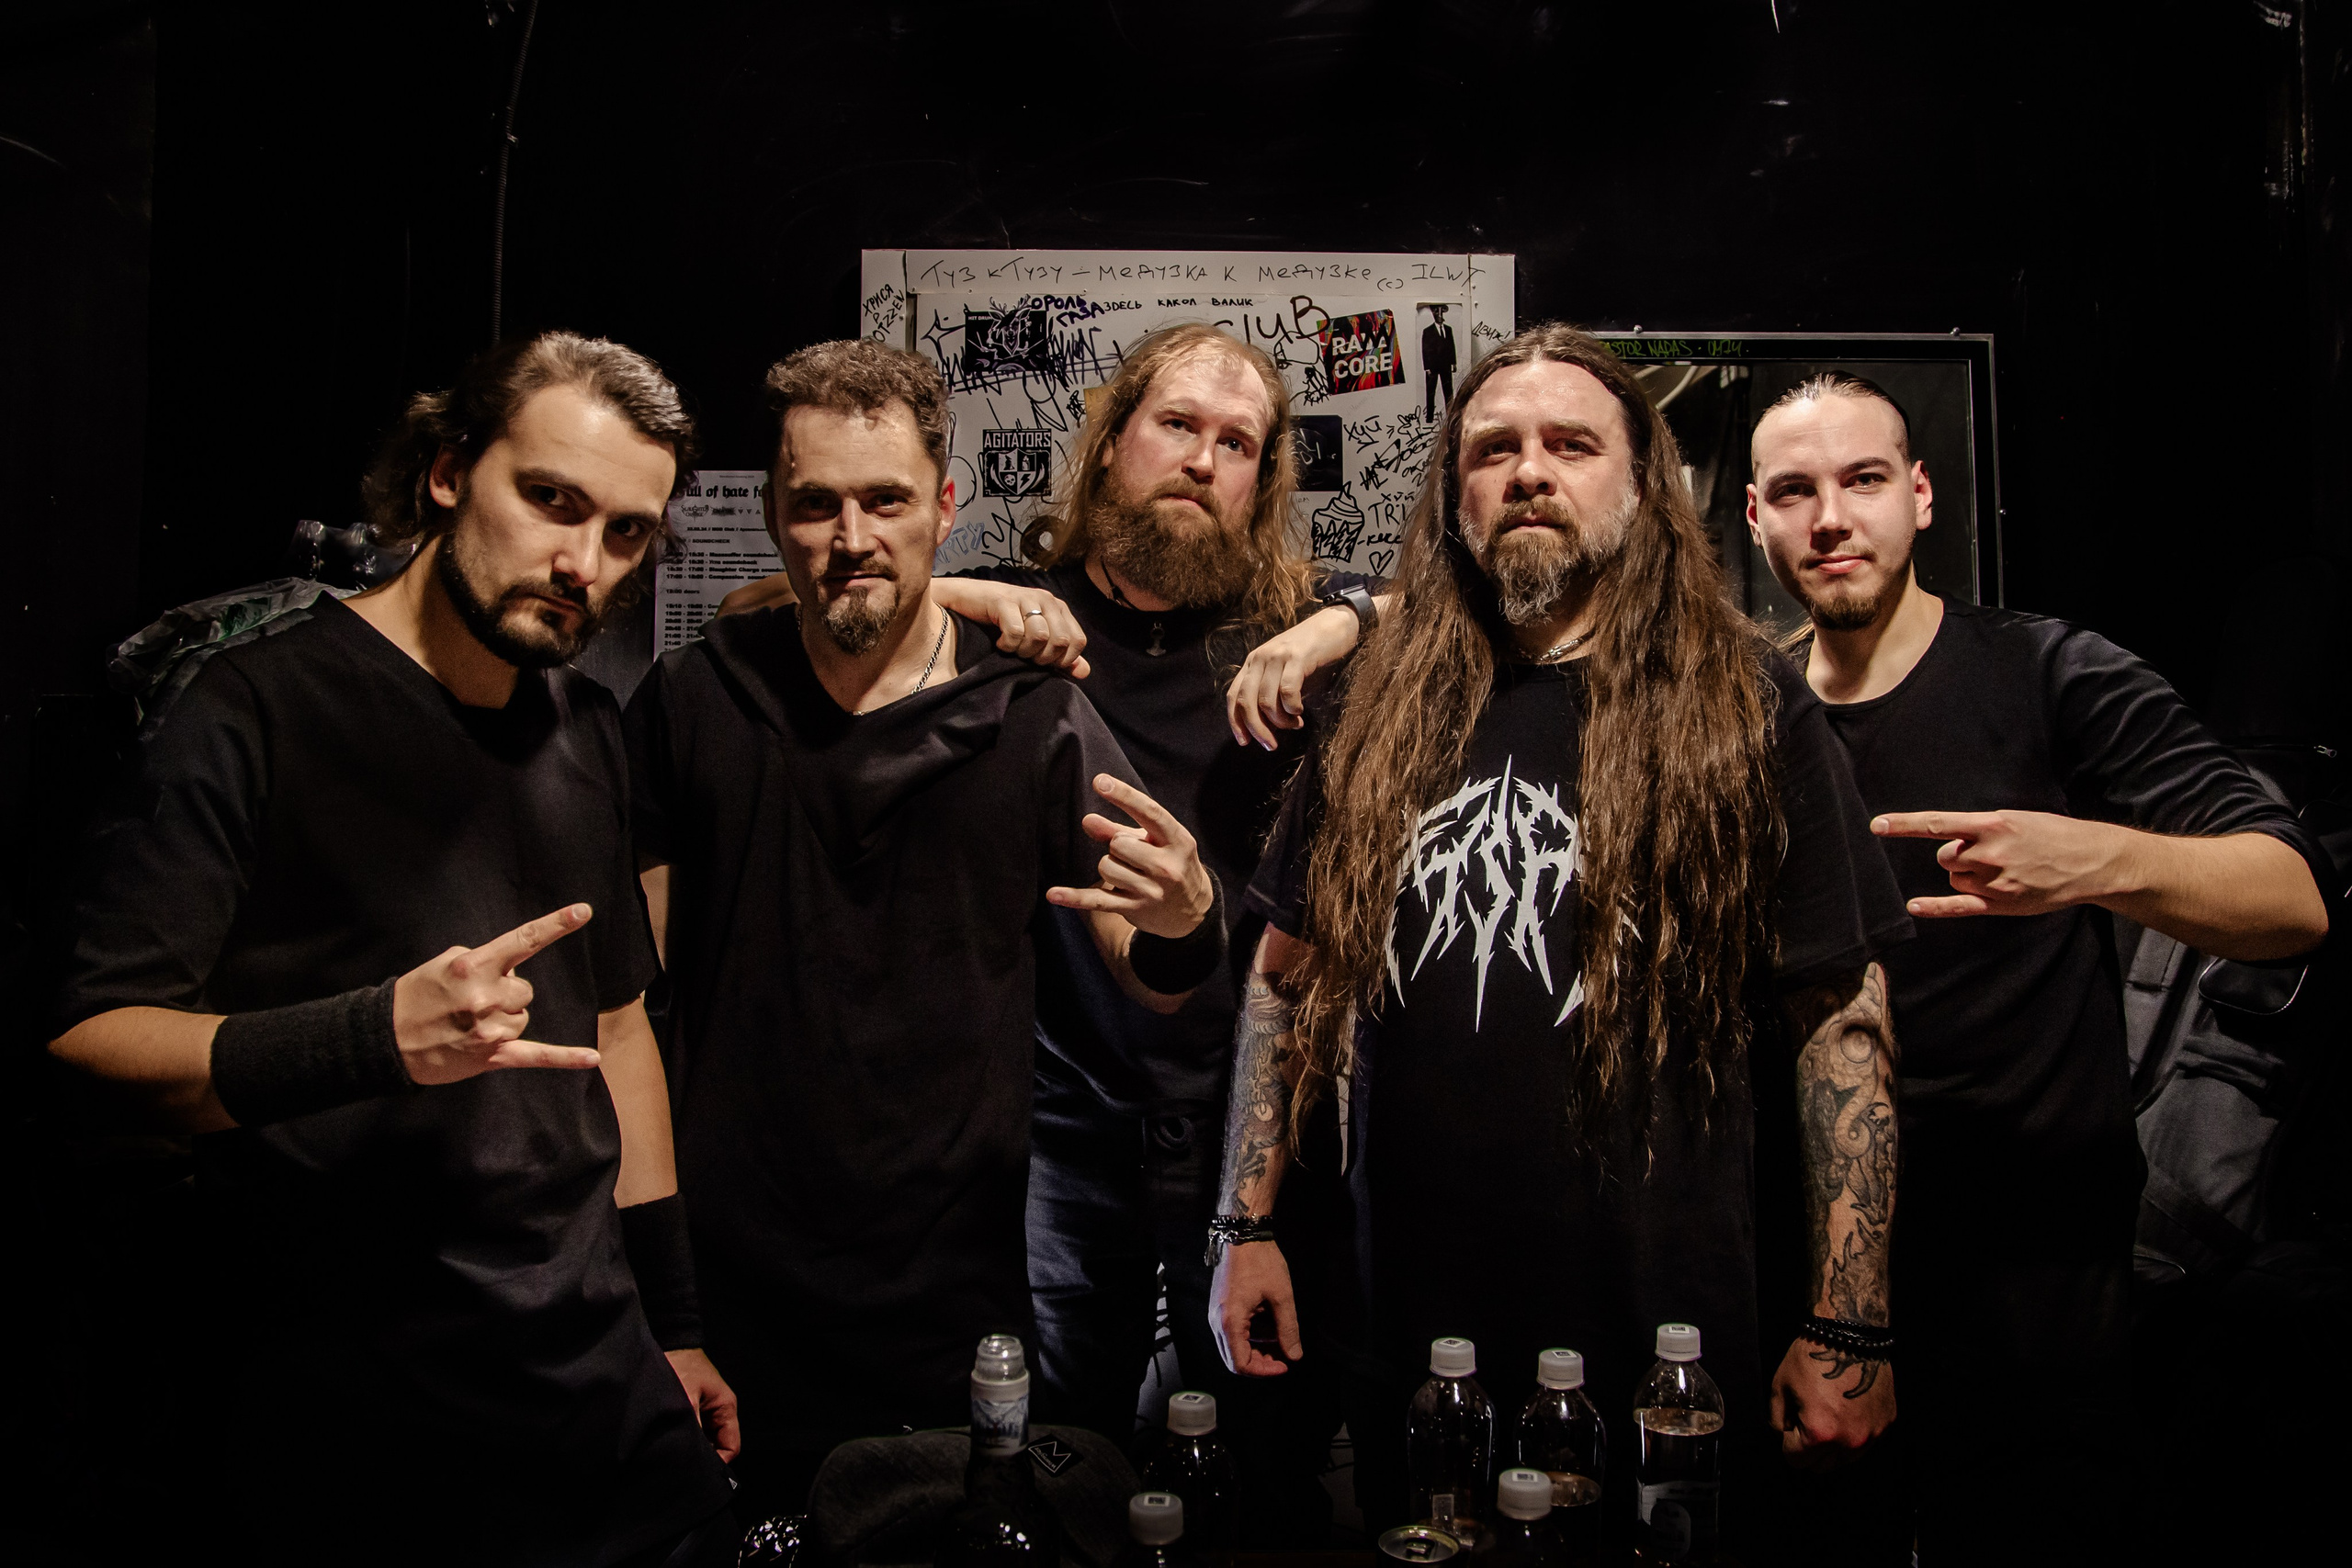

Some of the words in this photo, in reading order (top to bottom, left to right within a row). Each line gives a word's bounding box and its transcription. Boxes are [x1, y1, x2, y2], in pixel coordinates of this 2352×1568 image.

[1022, 294, 1087, 312] ОРОЛЬ
[1334, 352, 1394, 379] CORE
[984, 432, 1051, 448] AGITATORS
[722, 485, 749, 499] hate
